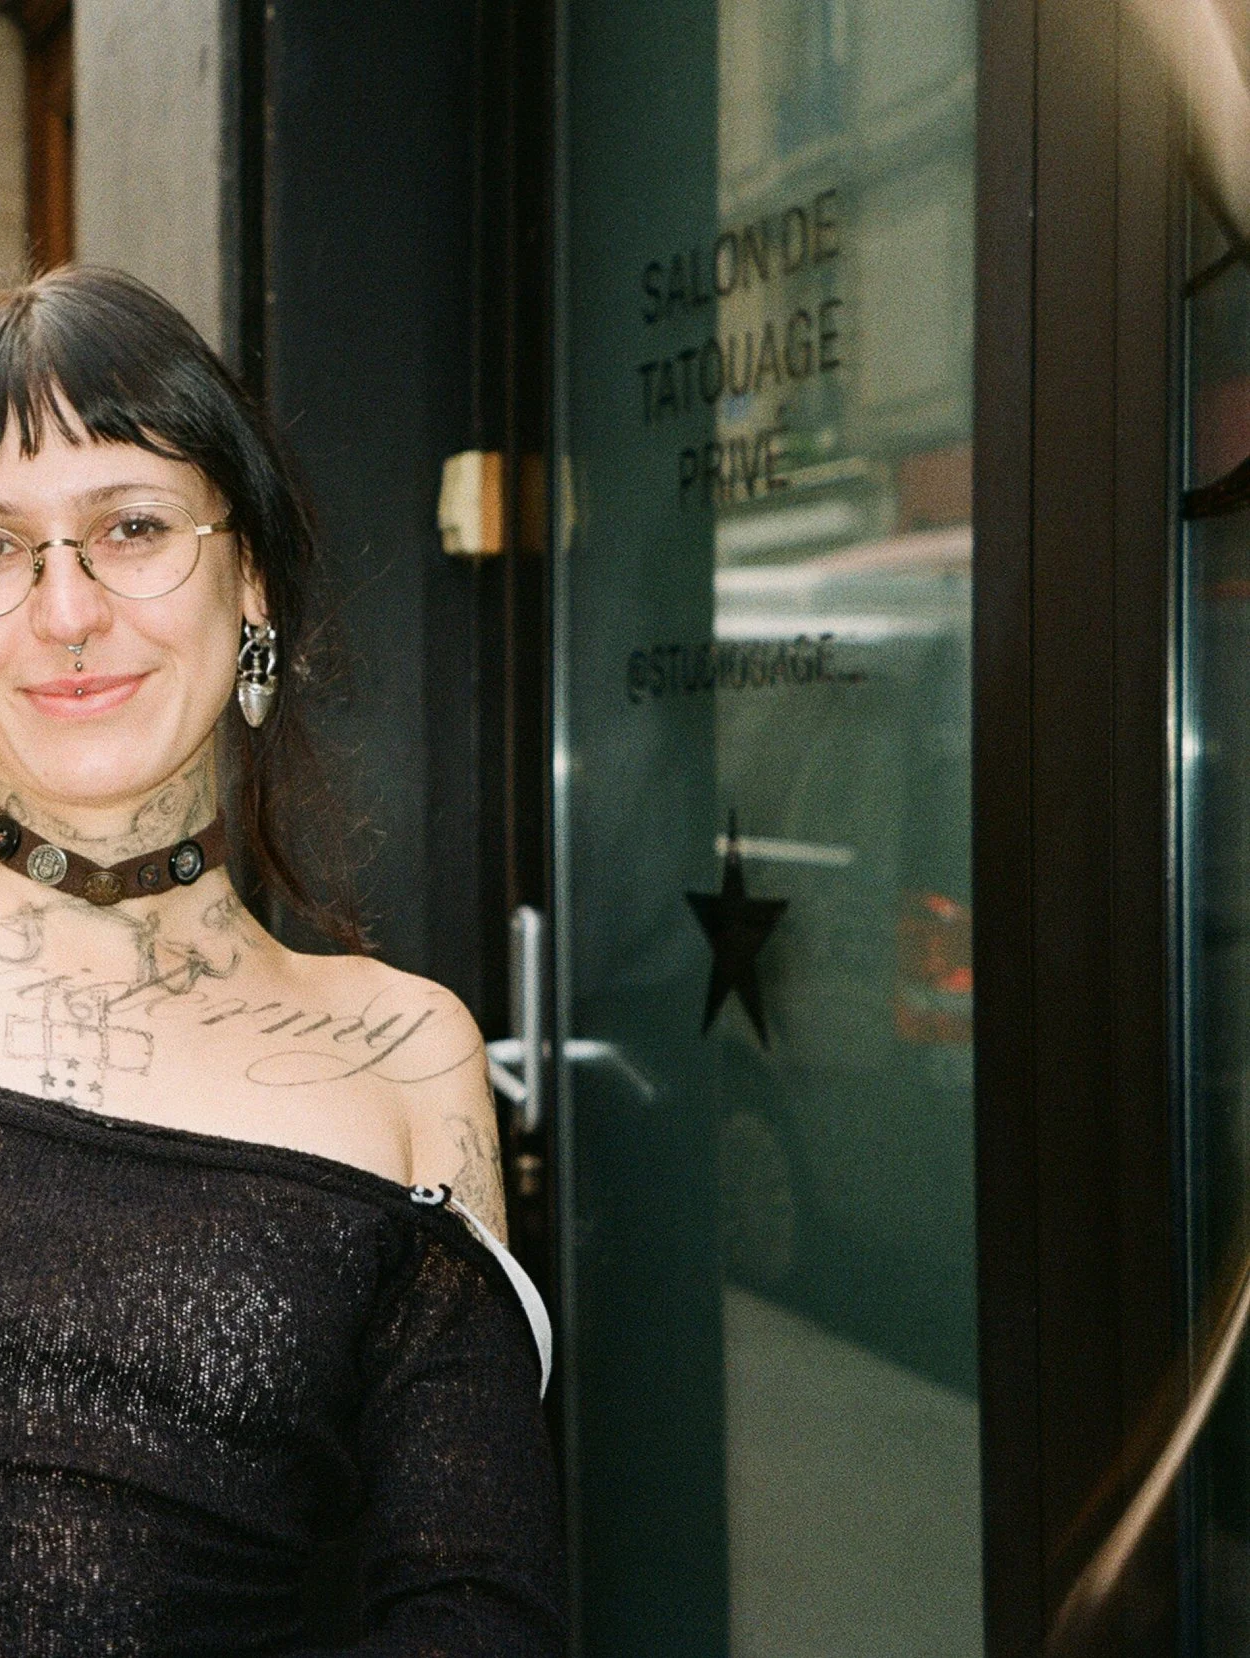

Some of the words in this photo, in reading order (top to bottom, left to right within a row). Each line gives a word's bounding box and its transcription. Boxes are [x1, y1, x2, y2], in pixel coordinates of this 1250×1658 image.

[640, 217, 771, 325] SALON
[781, 189, 841, 277] DE
[638, 297, 843, 424] TATOUAGE
[677, 404, 789, 510] PRIVÉ
